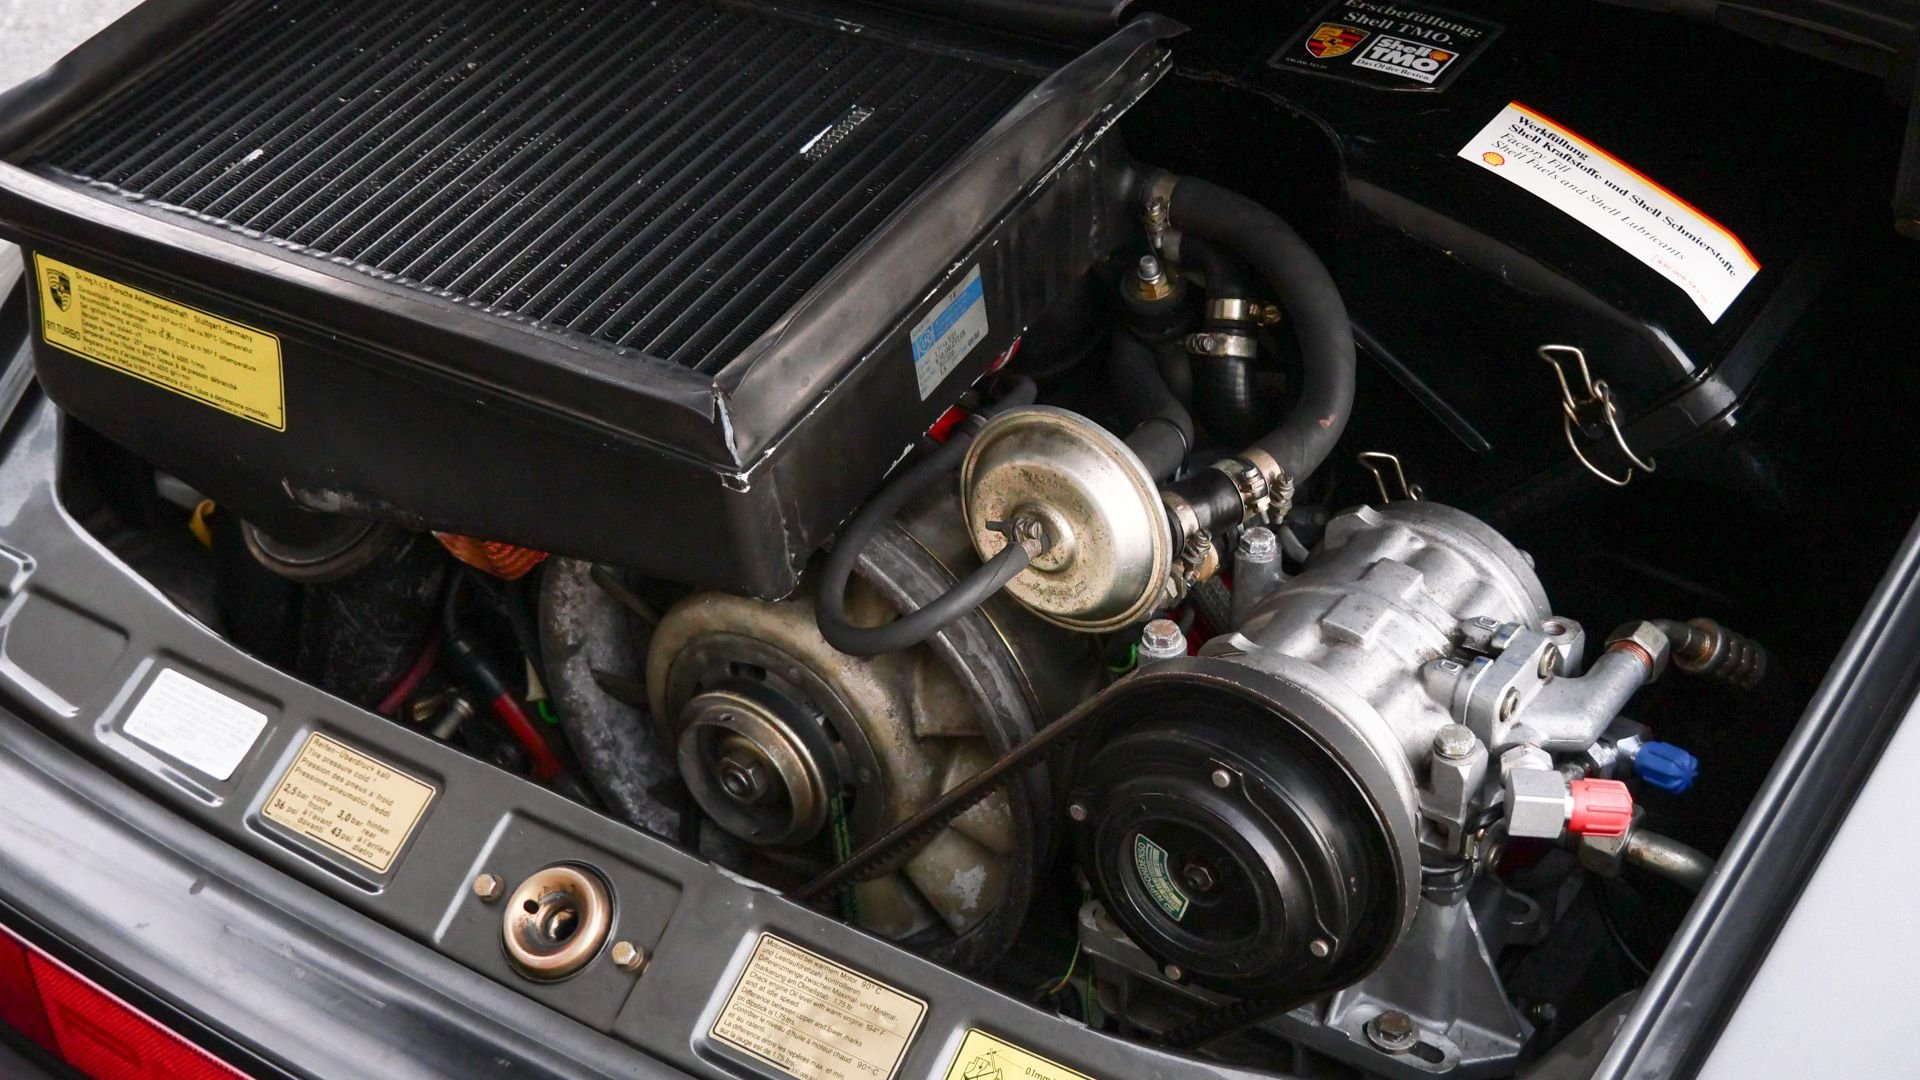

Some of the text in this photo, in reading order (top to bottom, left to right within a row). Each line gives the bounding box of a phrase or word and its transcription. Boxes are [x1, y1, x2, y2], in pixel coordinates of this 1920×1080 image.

[1344, 12, 1453, 45] Shell TMO.
[1377, 38, 1432, 57] Shell
[1369, 46, 1439, 72] TMO
[1500, 133, 1571, 173] Factory Fill
[1519, 116, 1589, 161] Werkfüllung
[1491, 140, 1686, 260] Shell Fuels and Shell Lubricants
[1508, 124, 1736, 278] Shell Kraftstoffe und Shell Schmierstoffe
[274, 798, 286, 809] 36
[331, 827, 342, 837] 43
[1137, 842, 1165, 903] NIPPONDENSO
[840, 972, 857, 983] Motor
